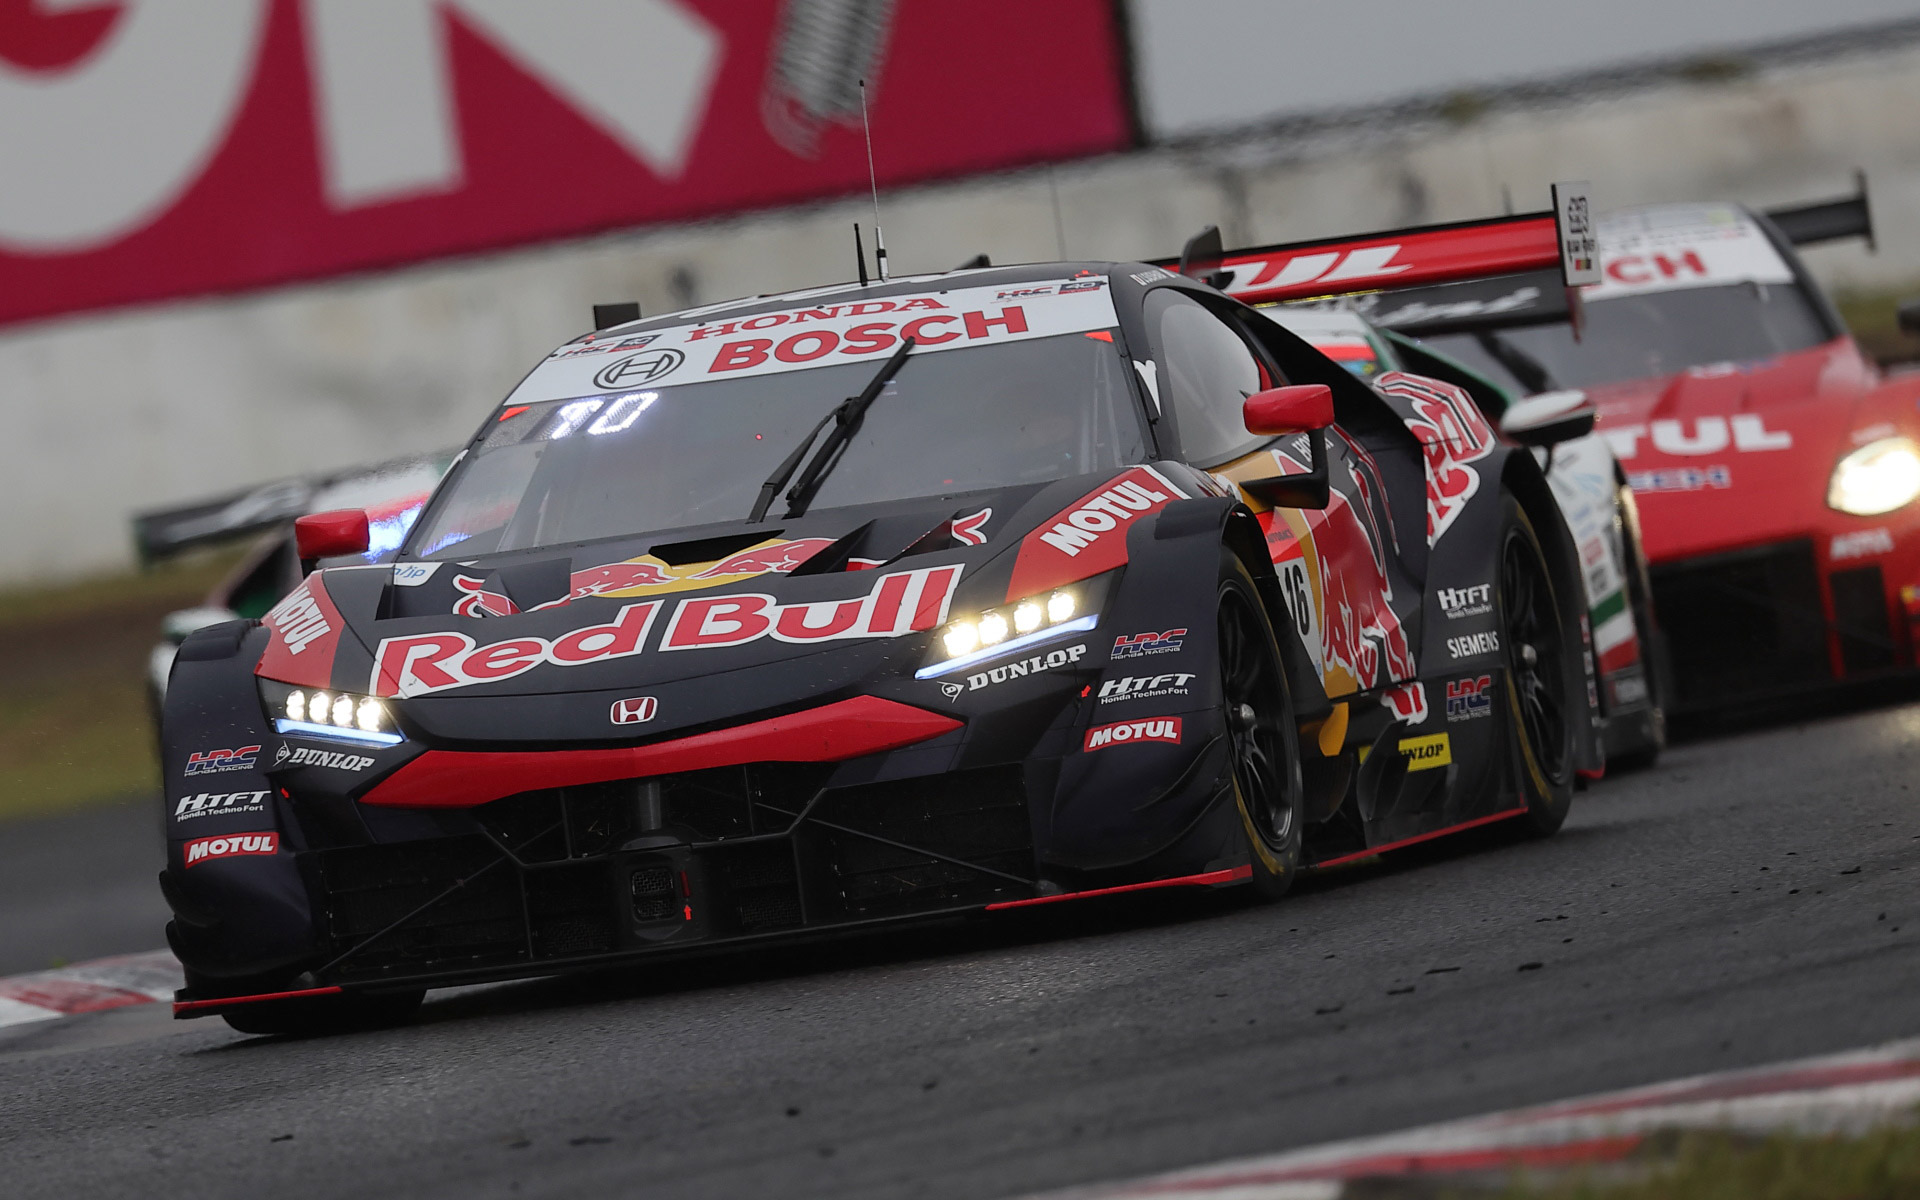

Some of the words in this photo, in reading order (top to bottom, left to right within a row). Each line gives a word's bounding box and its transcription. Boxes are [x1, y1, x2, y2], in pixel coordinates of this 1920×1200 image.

[684, 298, 950, 343] HONDA
[707, 306, 1029, 374] BOSCH
[1039, 480, 1168, 557] MOTUL
[1284, 564, 1310, 635] 16
[1437, 583, 1490, 610] HTFT
[270, 586, 331, 655] MOTUL
[370, 598, 665, 699] Red
[658, 564, 965, 651] Bull
[1111, 628, 1187, 656] HRC
[1111, 652, 1143, 661] Honda
[1145, 647, 1180, 656] RACING
[1447, 631, 1499, 659] SIEMENS
[967, 644, 1087, 692] DUNLOP
[1098, 673, 1196, 697] HTFT
[1101, 694, 1130, 705] Honda
[1132, 690, 1167, 699] Techno
[1168, 687, 1188, 695] Fort
[1447, 675, 1491, 714] HRC
[1089, 721, 1178, 748] MOTUL
[184, 768, 217, 777] Honda
[218, 764, 253, 773] RACING
[185, 745, 261, 772] HRC
[289, 748, 376, 772] DUNLOP
[174, 790, 271, 815] HTFT
[177, 810, 206, 822] Honda
[208, 805, 241, 816] Techno
[243, 804, 263, 812] Fort
[188, 836, 275, 862] MOTUL
